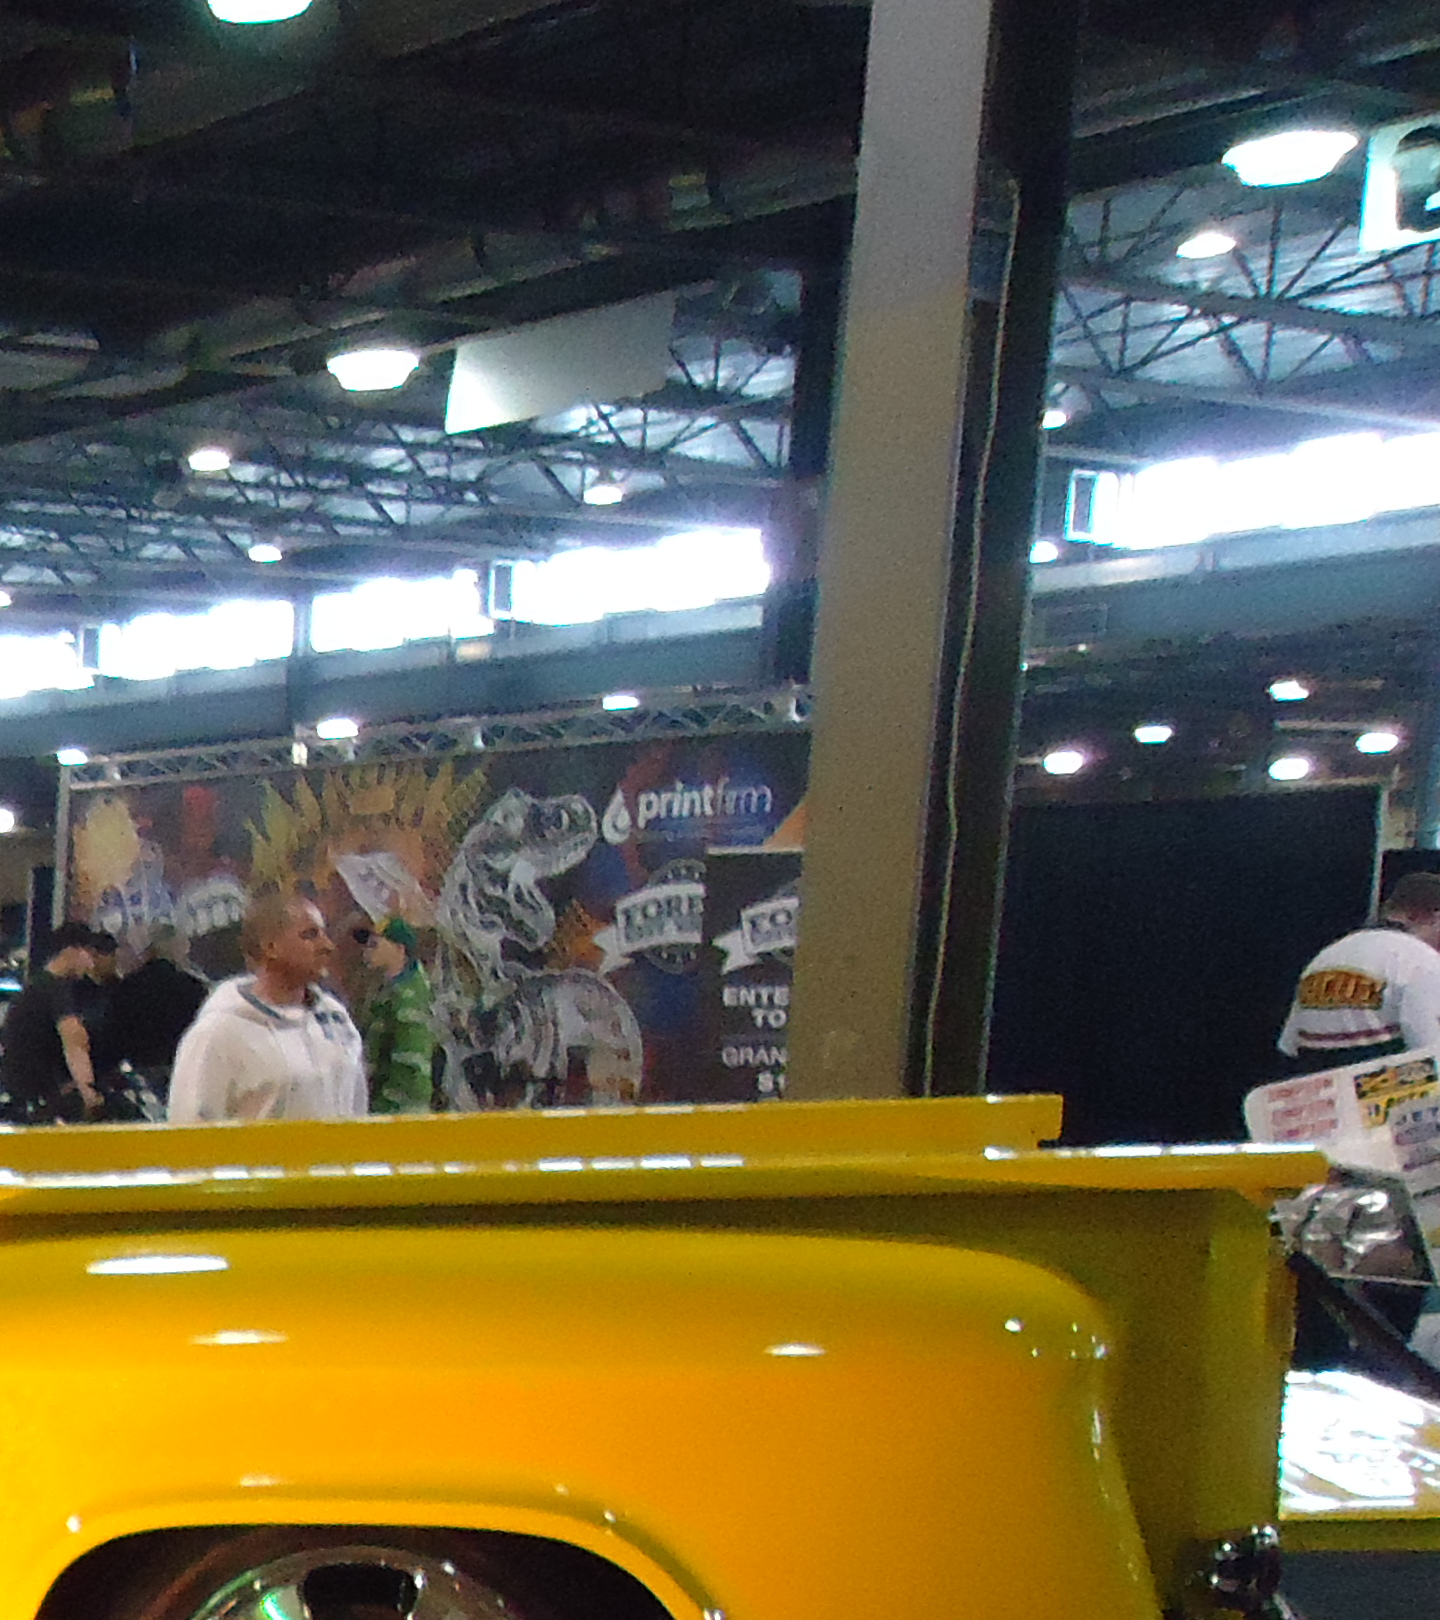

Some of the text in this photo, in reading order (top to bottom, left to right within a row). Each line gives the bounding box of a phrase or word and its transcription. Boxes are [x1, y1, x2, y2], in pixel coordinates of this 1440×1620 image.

[722, 985, 790, 1007] ENTE
[751, 1008, 787, 1029] TO
[721, 1046, 788, 1068] GRAN
